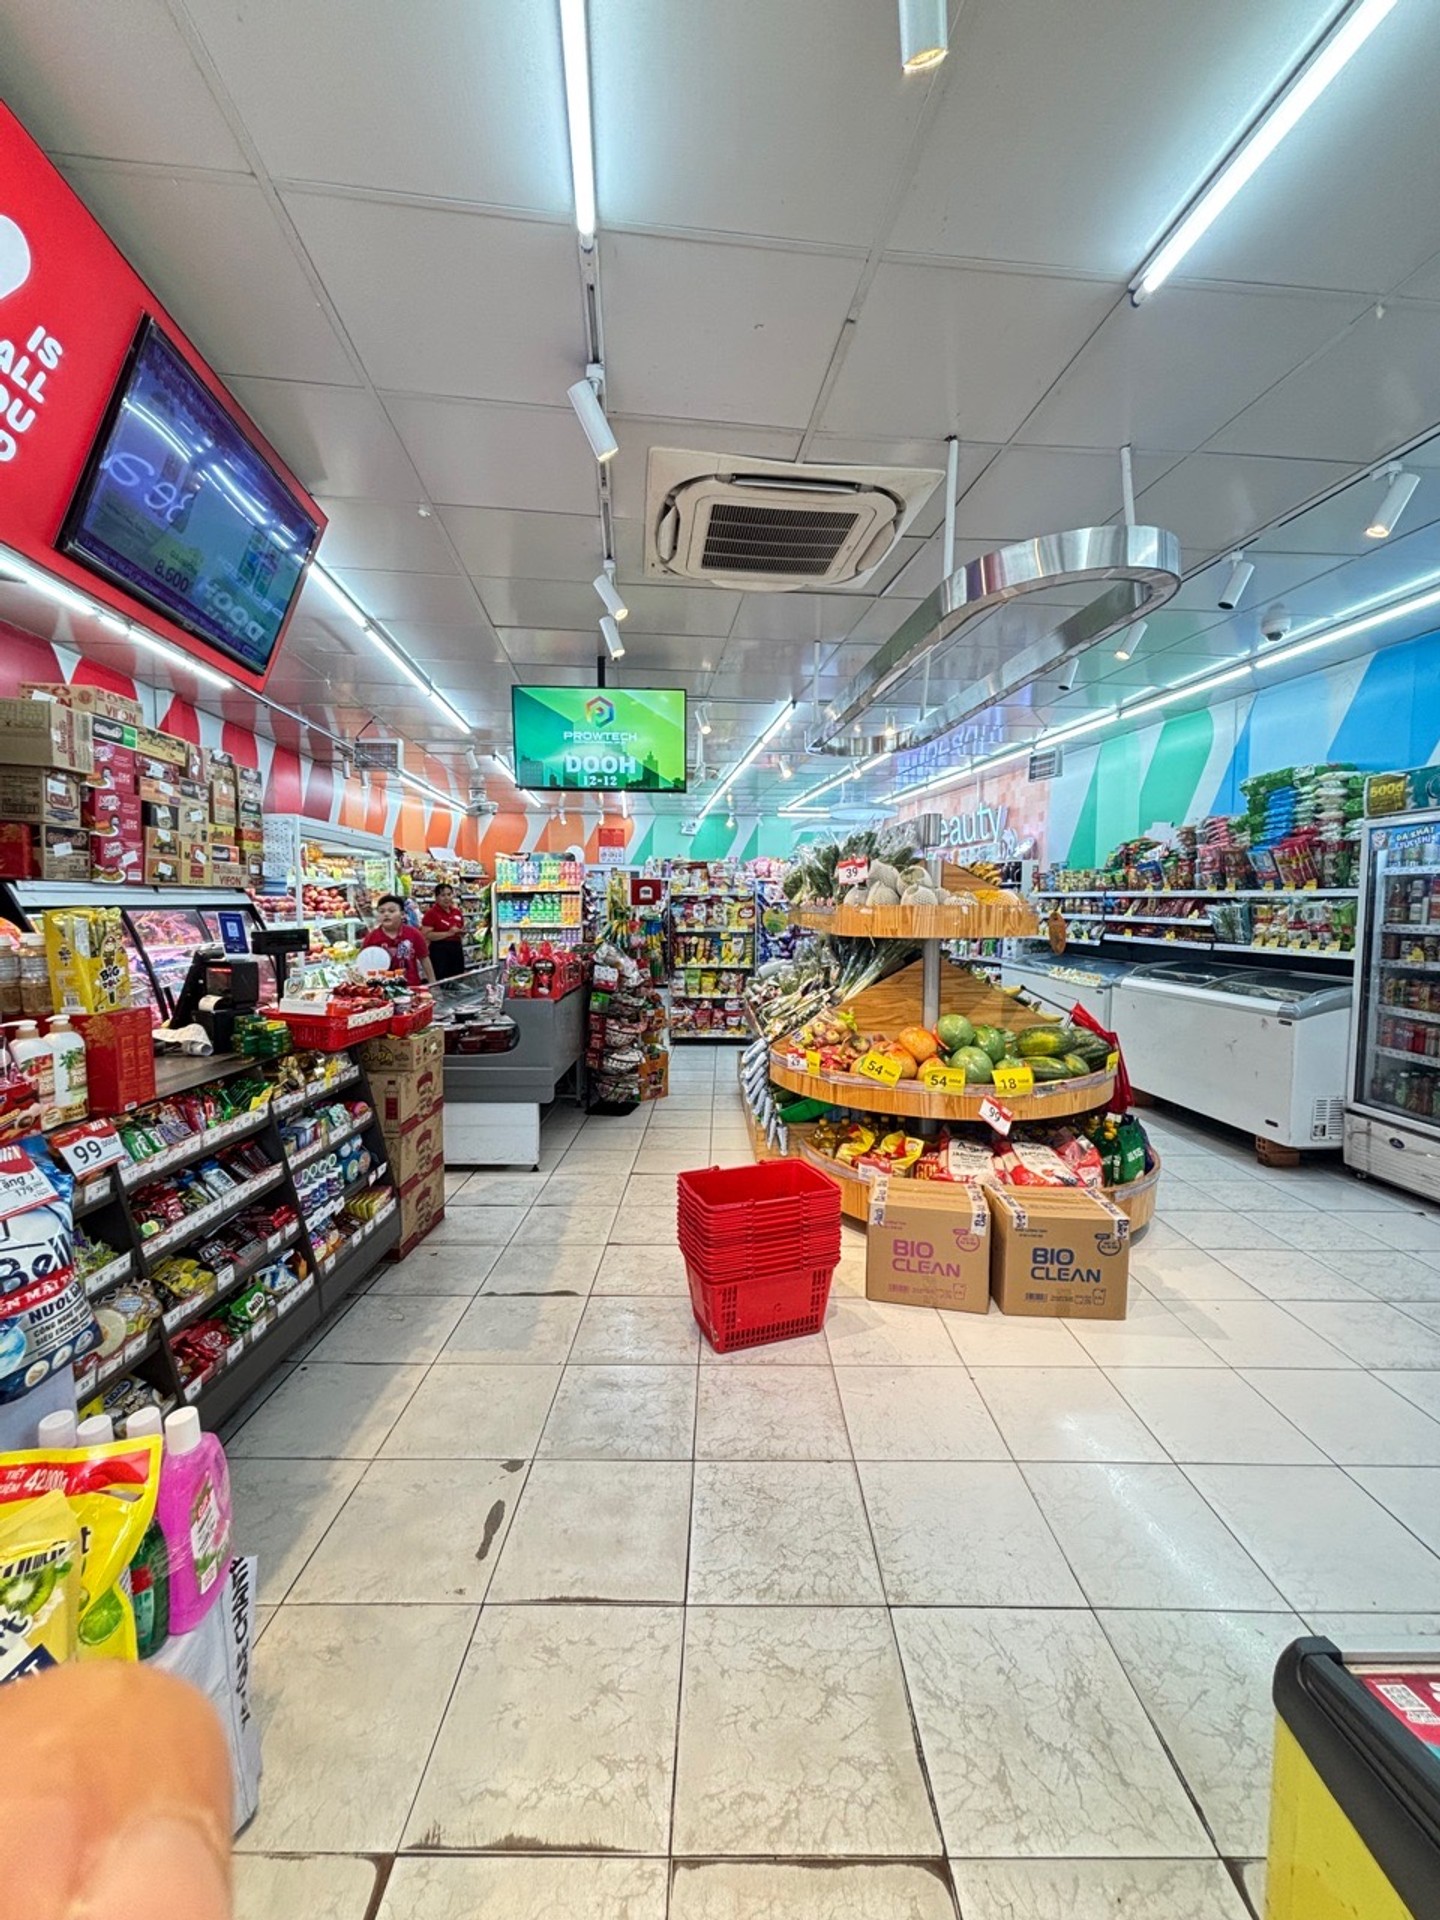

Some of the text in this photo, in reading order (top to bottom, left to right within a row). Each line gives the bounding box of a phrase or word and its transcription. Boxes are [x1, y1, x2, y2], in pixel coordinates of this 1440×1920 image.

[564, 754, 637, 775] DOOH
[583, 775, 618, 786] 12-12
[940, 802, 1003, 847] eauty
[845, 867, 859, 879] 39
[866, 1059, 883, 1076] 54
[930, 1074, 948, 1088] 54
[1000, 1078, 1017, 1090] 18
[73, 1140, 102, 1164] 99
[893, 1239, 935, 1259] BIO
[1031, 1247, 1075, 1265] BIO
[891, 1258, 961, 1278] CLEAN
[1030, 1266, 1102, 1283] CLEAN
